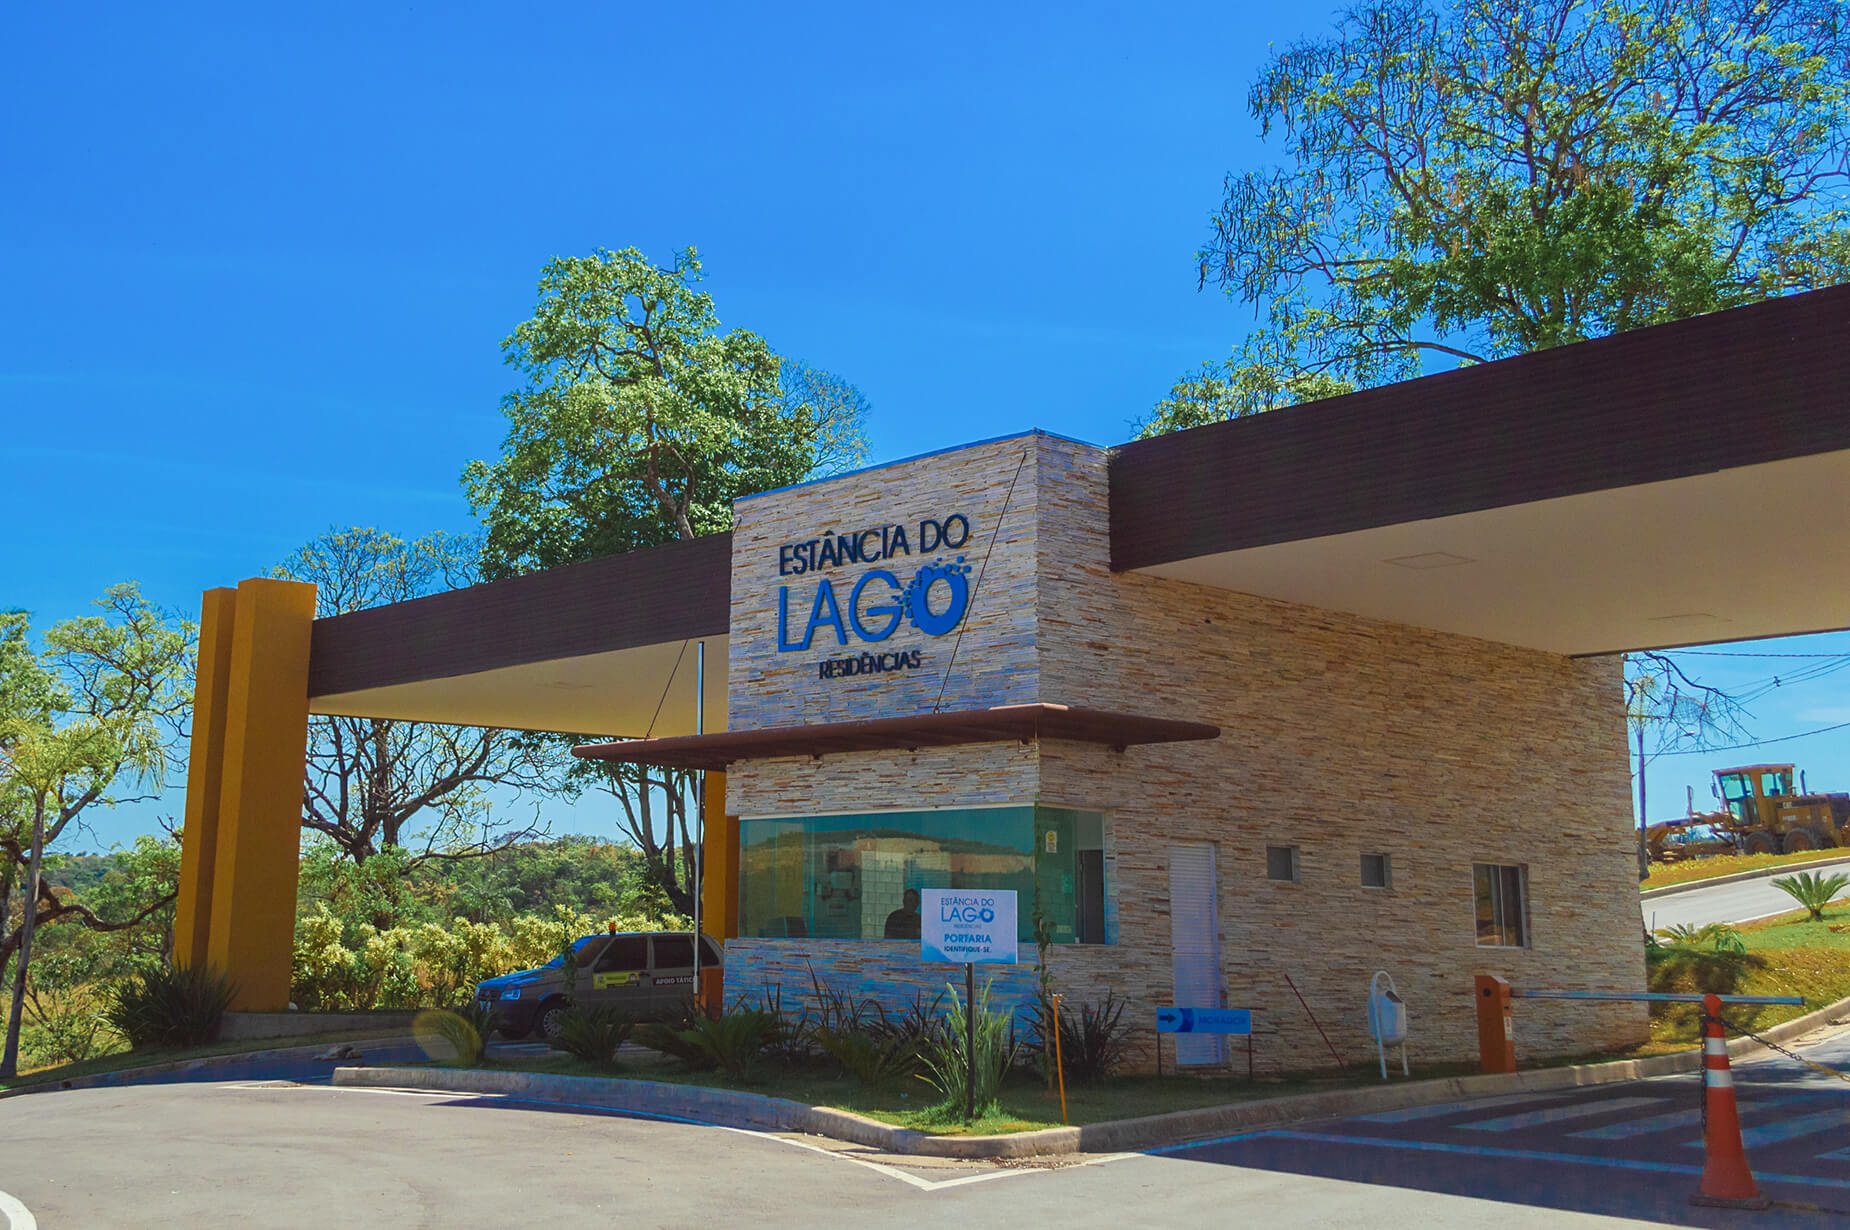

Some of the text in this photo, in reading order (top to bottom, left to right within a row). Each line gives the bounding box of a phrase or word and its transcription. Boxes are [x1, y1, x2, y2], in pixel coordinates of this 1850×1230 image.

[779, 514, 970, 576] ESTÂNCIA DO
[778, 557, 971, 653] LAGO
[818, 650, 922, 680] RESIDÊNCIAS
[941, 896, 994, 906] ESTÂNCIA DO
[941, 906, 995, 923] LAGO
[944, 934, 992, 944] PORTARIA
[1198, 1015, 1246, 1024] MORADOR
